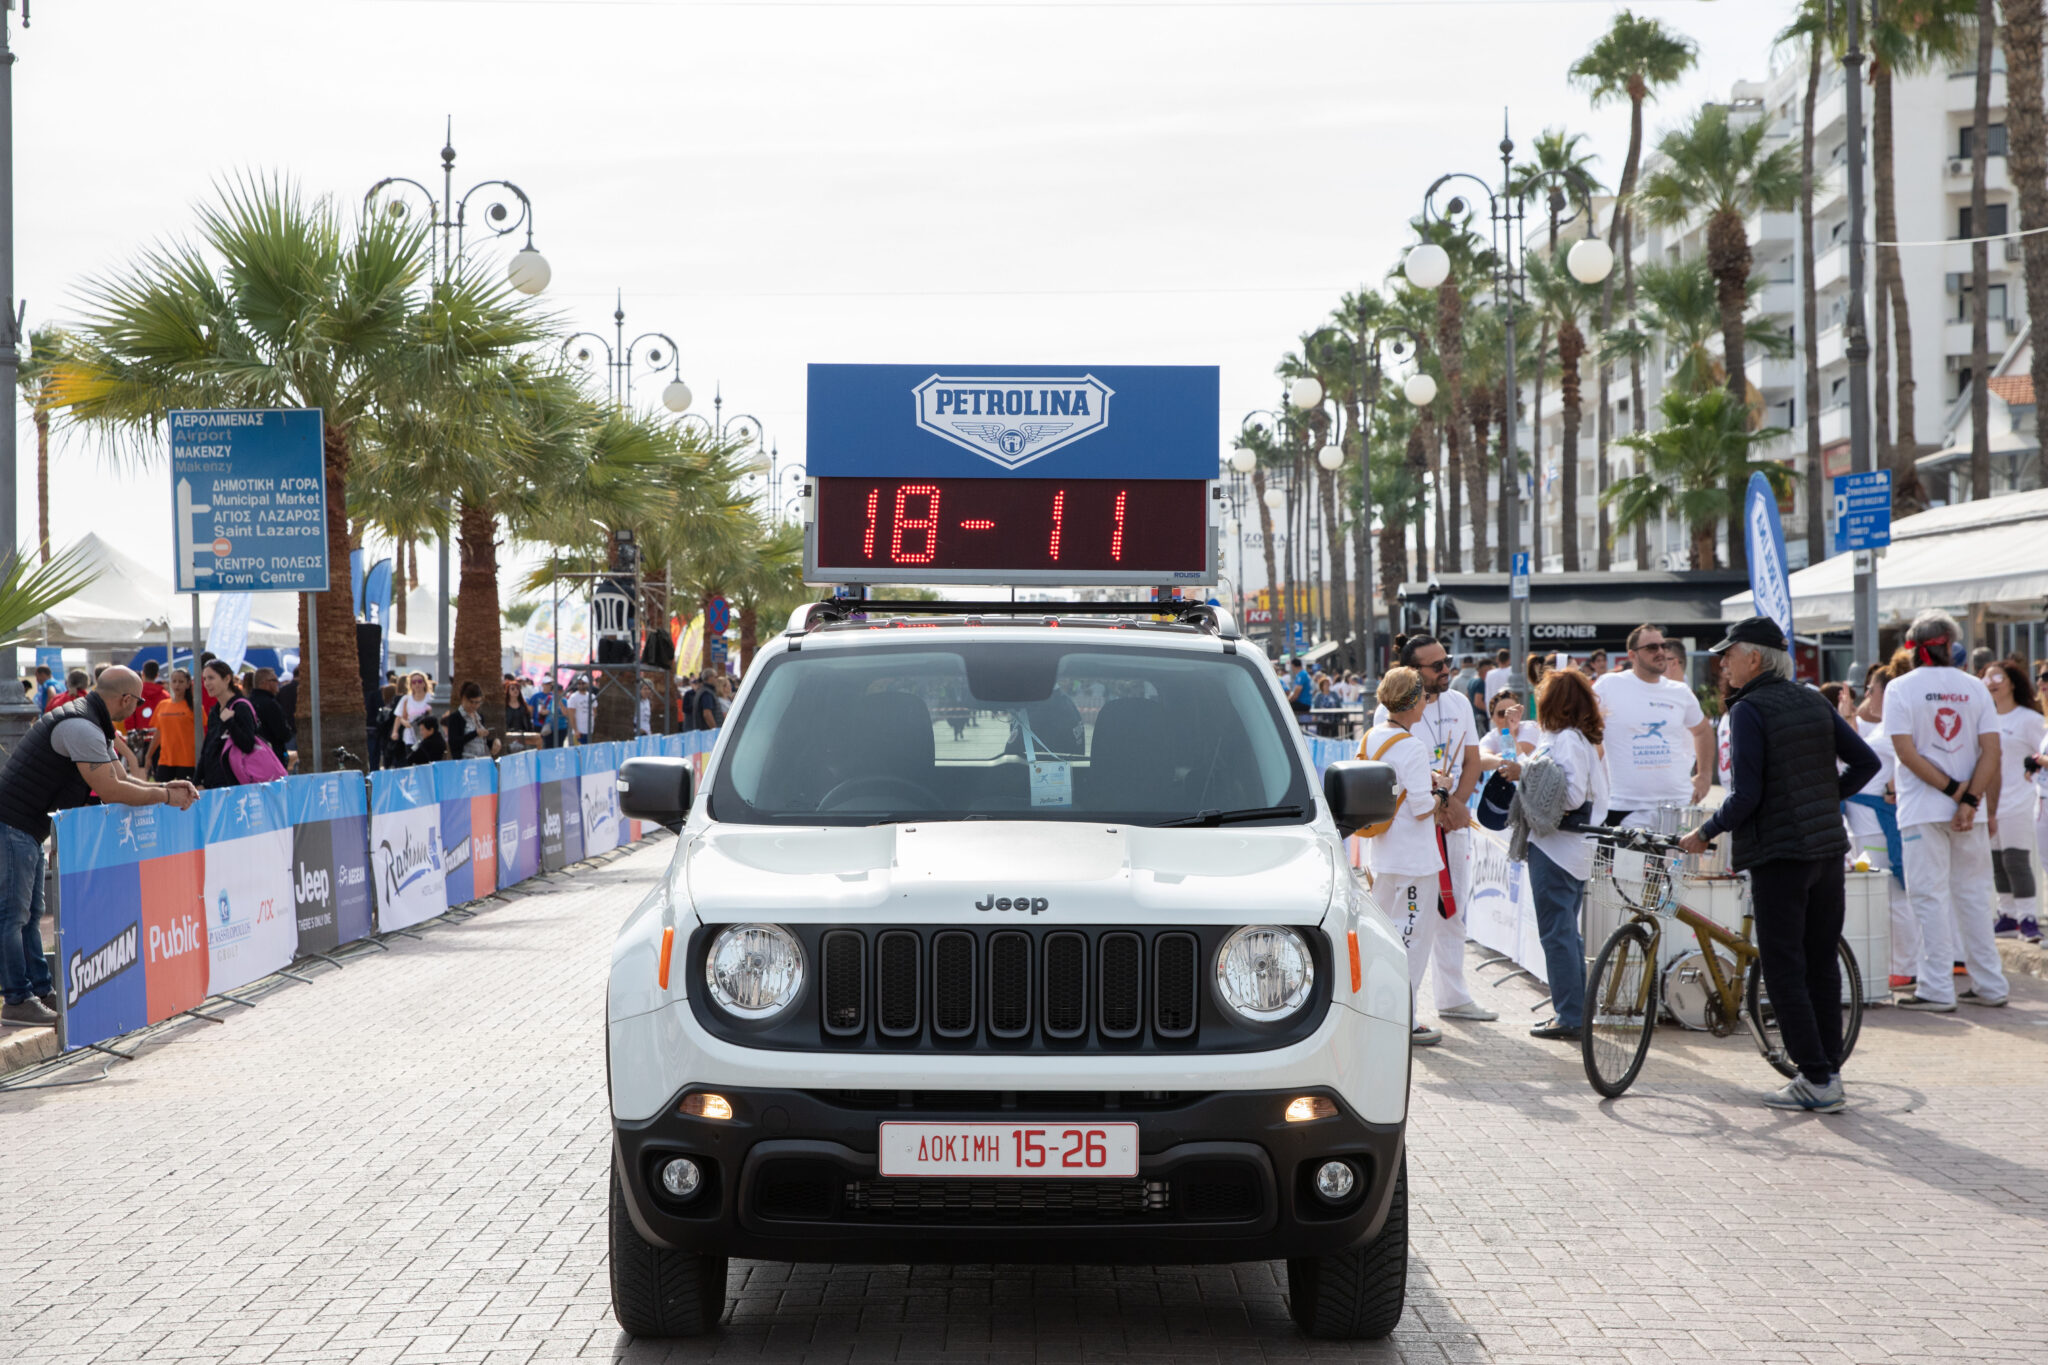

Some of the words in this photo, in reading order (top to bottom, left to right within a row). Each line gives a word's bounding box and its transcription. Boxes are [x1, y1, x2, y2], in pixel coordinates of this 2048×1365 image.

[935, 389, 1090, 416] PETROLINA
[174, 413, 264, 427] ΑΕΡΟΛΙΜΕΝΑΣ
[175, 429, 232, 443] Airport
[175, 445, 232, 458] ΜΑΚΕΝΖΥ
[175, 460, 232, 473] Makenzy
[212, 479, 274, 491] ΔΗΜΟΤΙΚΗ
[280, 478, 319, 490] ΑΓΟΡΑ
[212, 493, 270, 508] Municipal
[276, 492, 320, 505] Market
[213, 510, 252, 523] ΑΓΙΟΣ
[258, 509, 321, 522] ΛΑΖΑΡΟΣ
[1834, 494, 1848, 534] P
[214, 525, 252, 537] Saint
[256, 524, 320, 537] Lazaros
[215, 557, 265, 570] ΚΕΝΤΡΟ
[271, 556, 322, 569] ΠΟΛΕΩΣ
[216, 572, 254, 584] Town
[260, 570, 305, 583] Centre
[1533, 625, 1596, 638] CORNER
[543, 807, 561, 840] Jeep
[295, 861, 330, 908] Jeep
[975, 893, 1049, 915] Jeep
[149, 914, 200, 964] Public
[918, 1135, 1000, 1162] ΔΟΚΙΜΗ
[1012, 1130, 1107, 1168] 15-26
